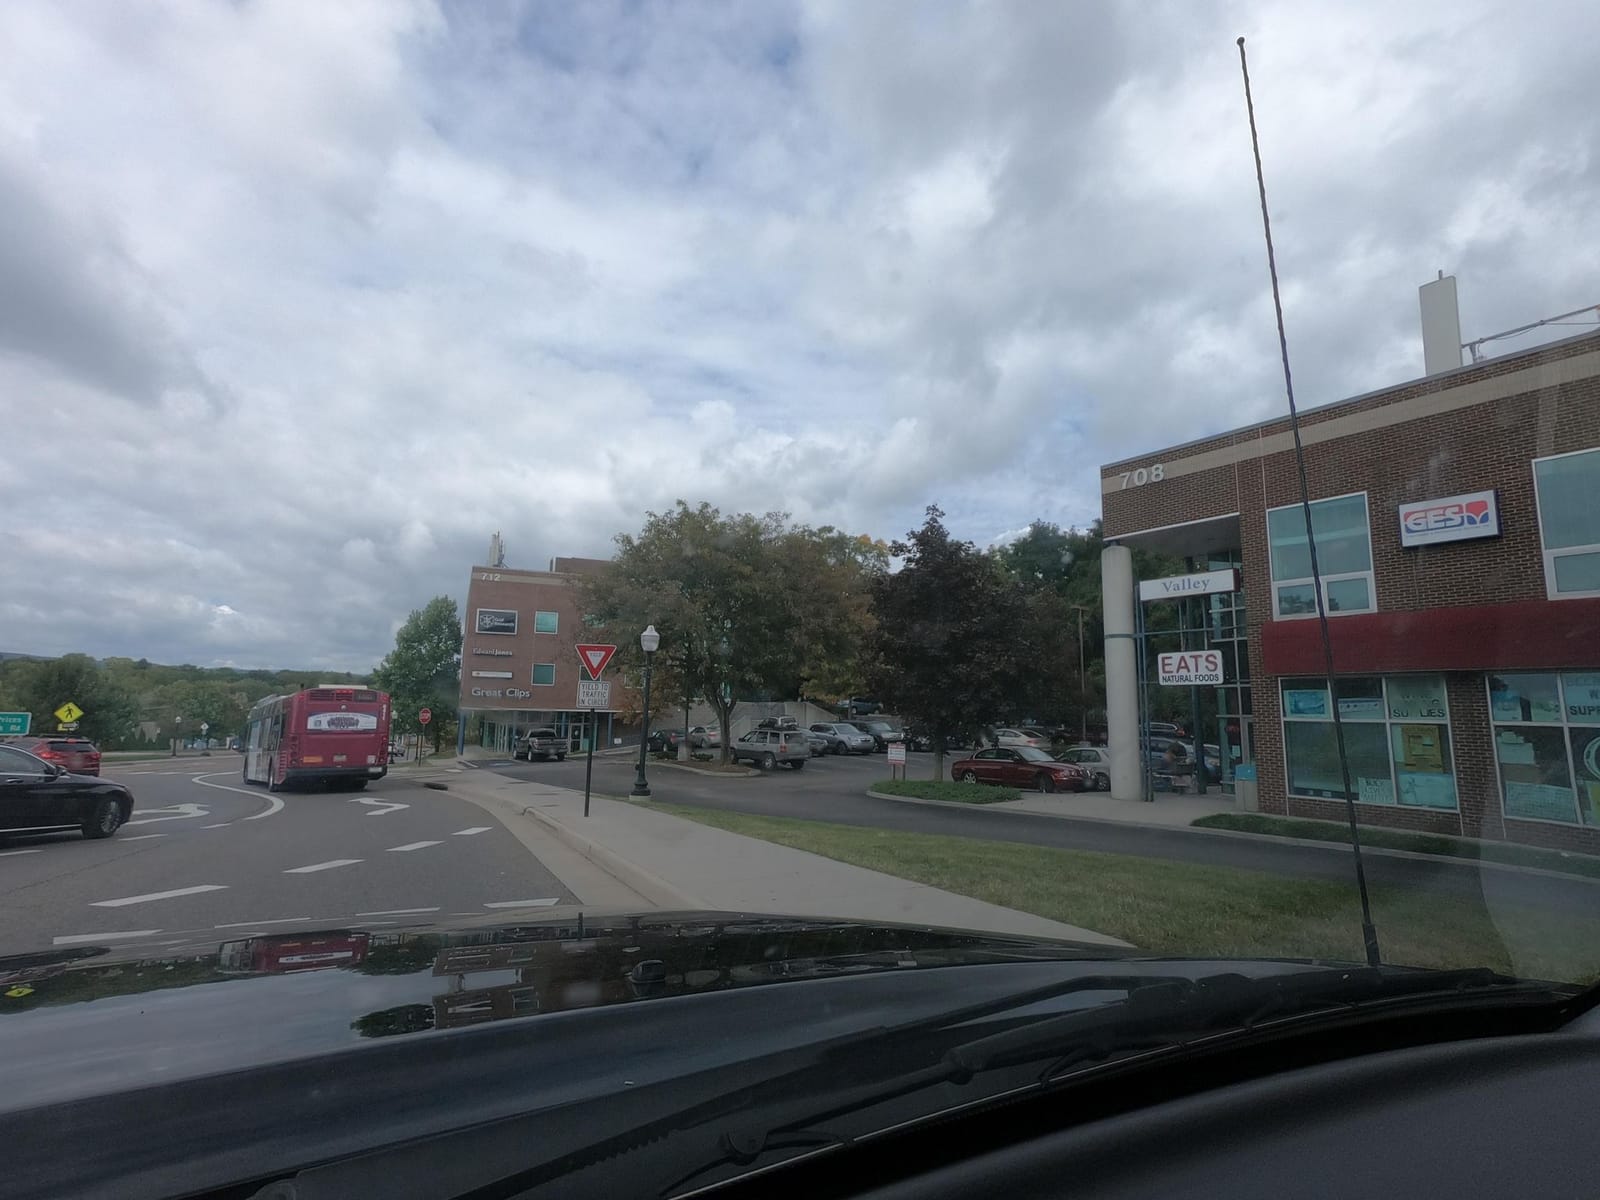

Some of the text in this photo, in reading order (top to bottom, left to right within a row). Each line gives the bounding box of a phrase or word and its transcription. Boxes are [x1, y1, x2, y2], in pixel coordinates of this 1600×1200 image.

[1119, 463, 1165, 490] 708
[481, 572, 501, 582] 712
[1162, 578, 1211, 593] Valley
[1161, 653, 1218, 674] EATS
[1162, 673, 1219, 683] NATURAL FOODS
[471, 687, 530, 700] Great Clips
[581, 683, 599, 691] YIELD
